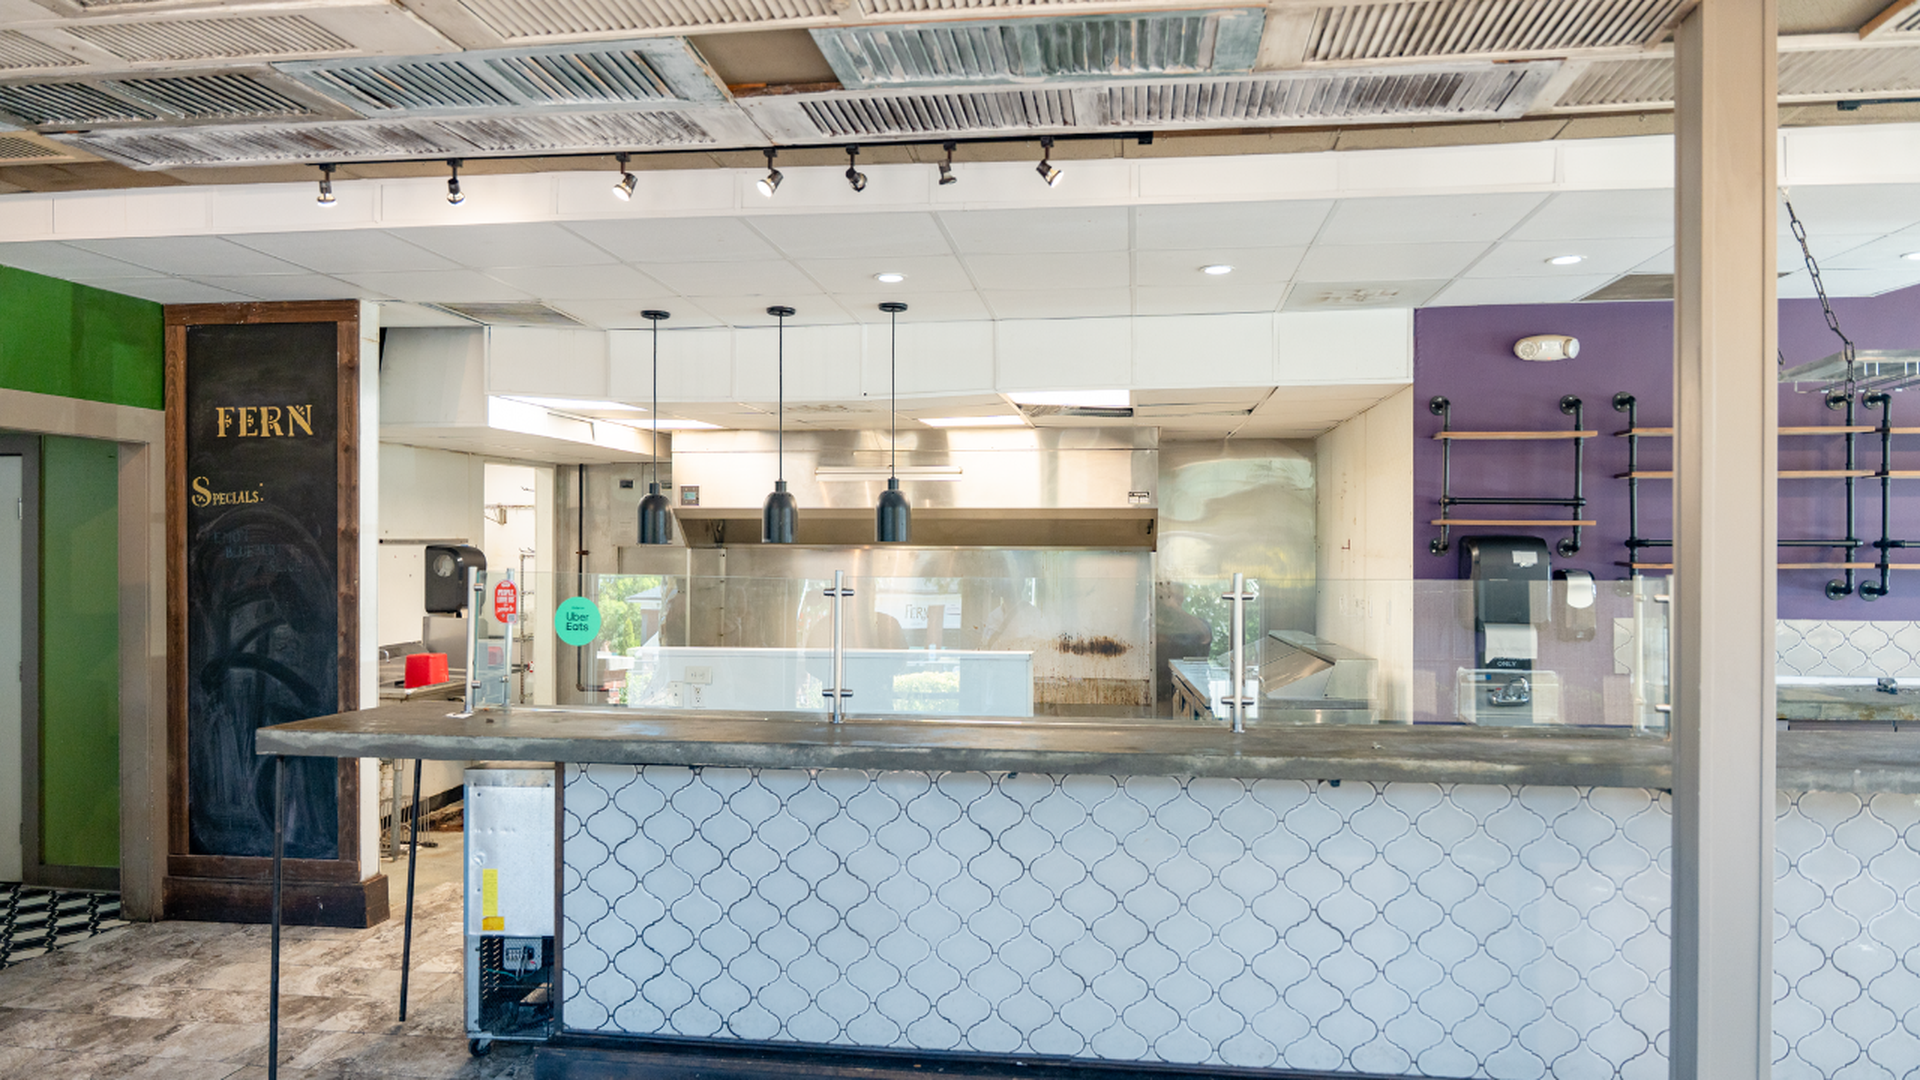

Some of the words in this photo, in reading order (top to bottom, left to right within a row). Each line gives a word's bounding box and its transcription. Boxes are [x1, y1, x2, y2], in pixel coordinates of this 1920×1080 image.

[215, 404, 314, 438] FERN
[566, 612, 589, 622] Uber
[566, 622, 589, 632] Eats
